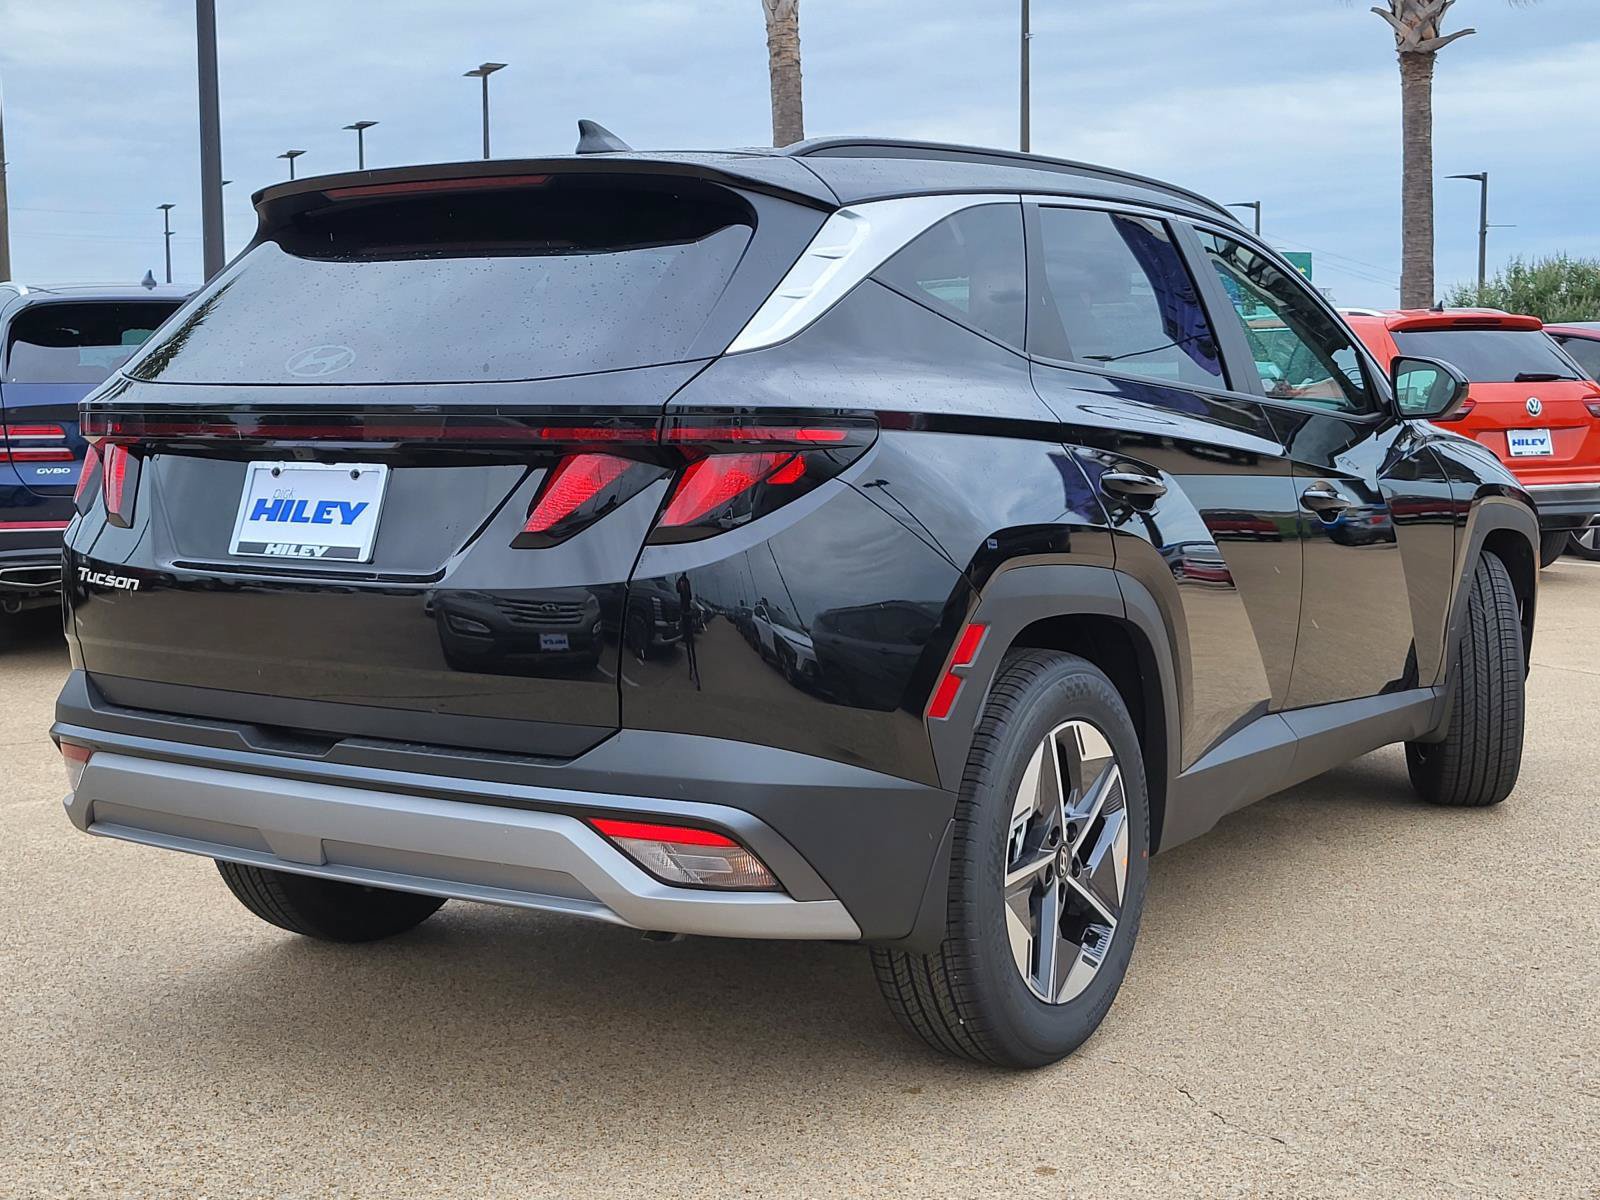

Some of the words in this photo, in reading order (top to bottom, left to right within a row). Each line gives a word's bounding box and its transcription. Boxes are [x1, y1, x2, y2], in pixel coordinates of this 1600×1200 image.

[1512, 438, 1546, 446] HILEY
[249, 498, 369, 525] HILEY
[264, 543, 330, 557] HILEY
